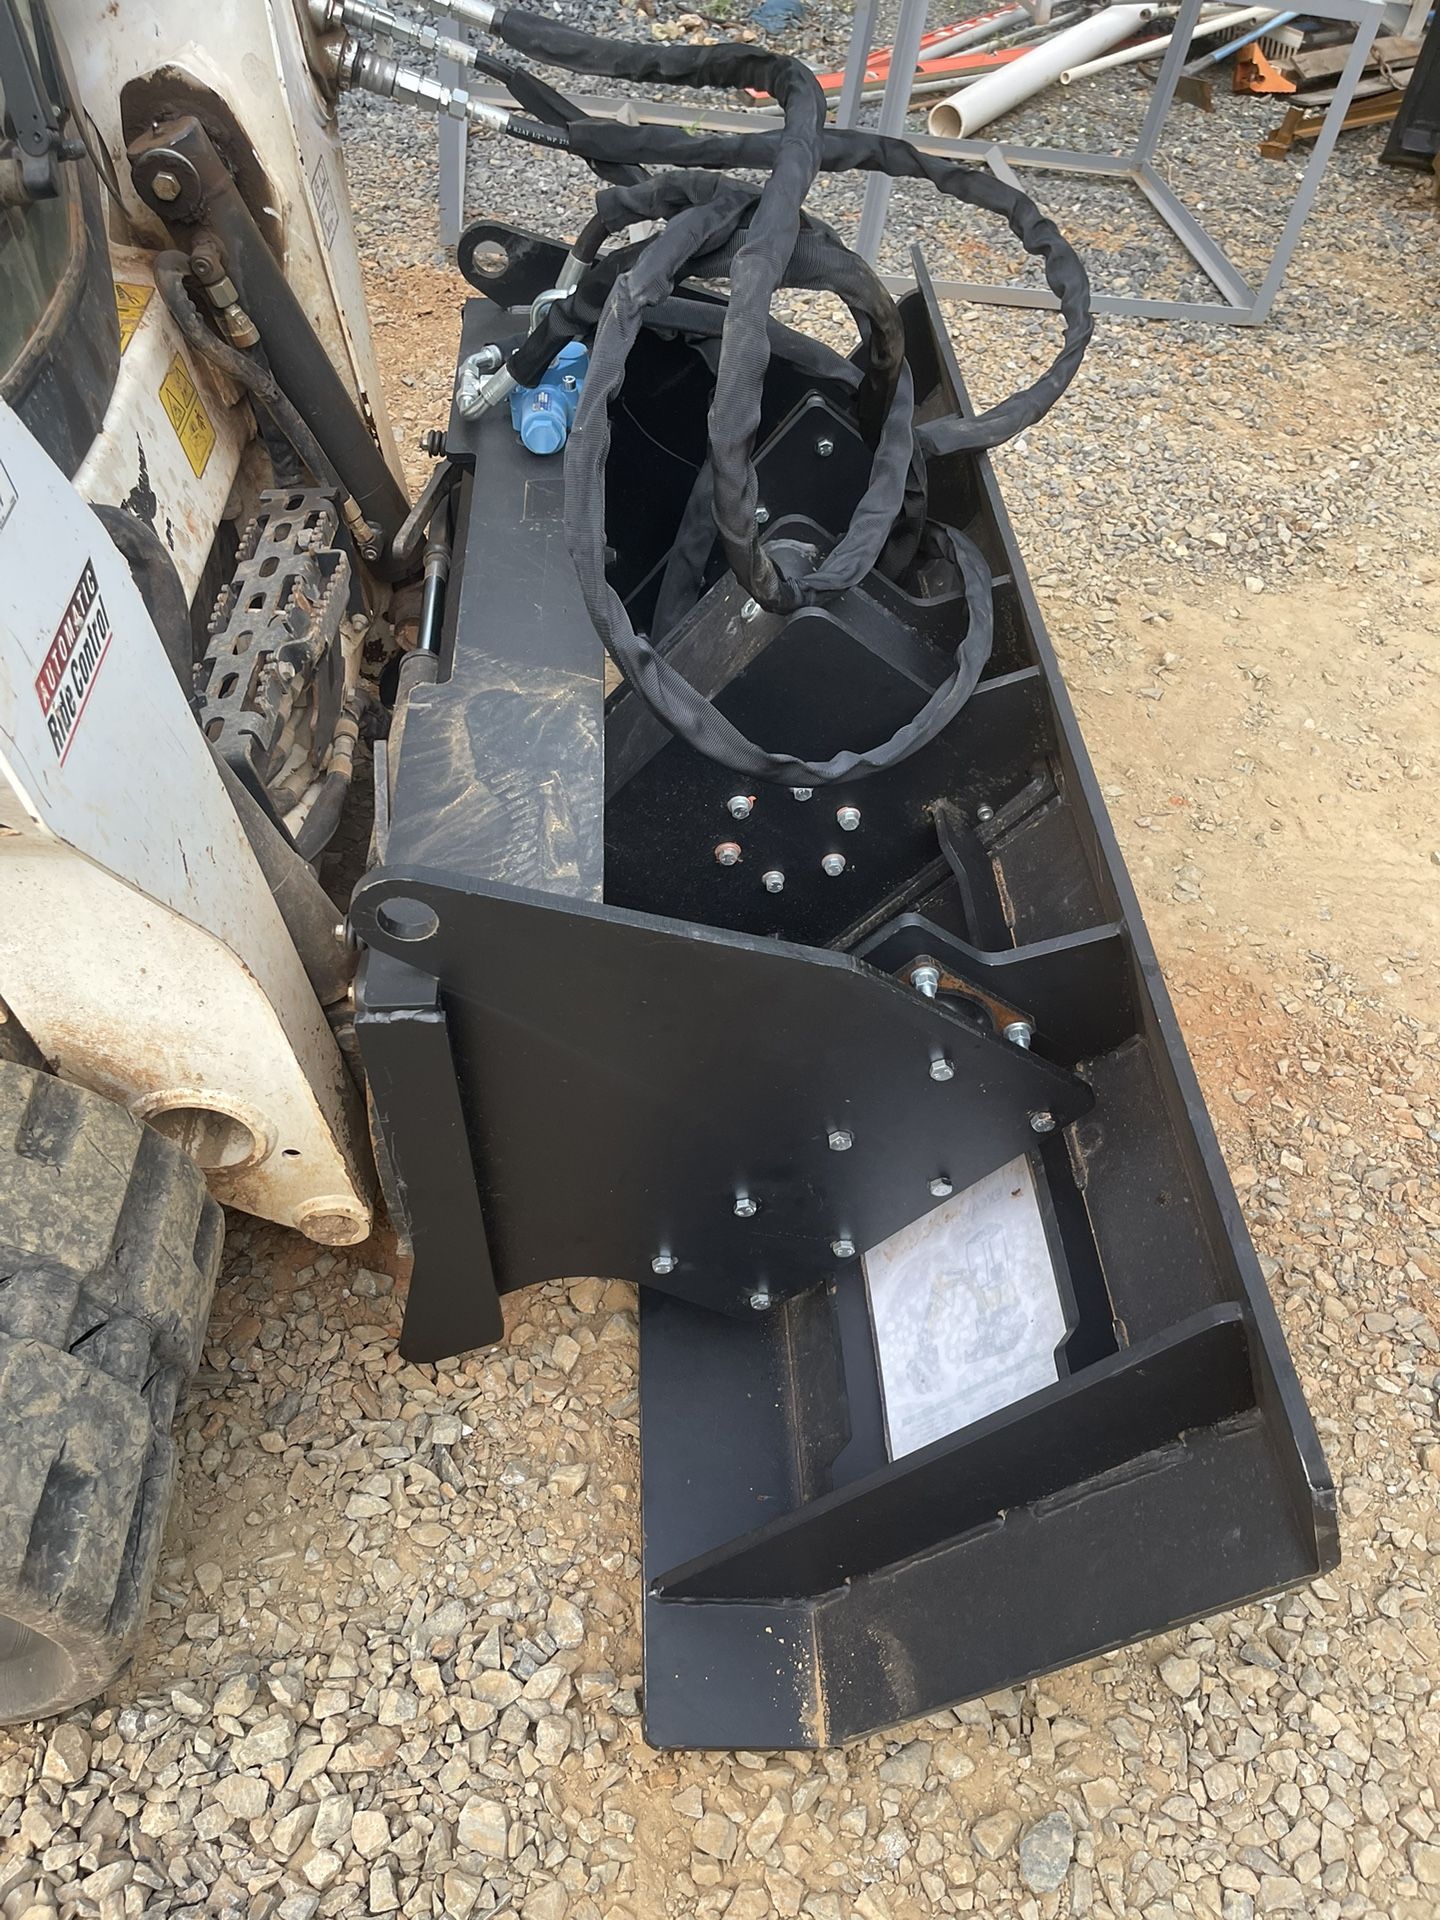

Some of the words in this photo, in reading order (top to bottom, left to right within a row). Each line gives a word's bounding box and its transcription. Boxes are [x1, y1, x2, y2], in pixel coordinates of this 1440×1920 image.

[39, 568, 97, 708] AUTOMATIC
[47, 684, 77, 758] Ride
[70, 593, 110, 700] Control
